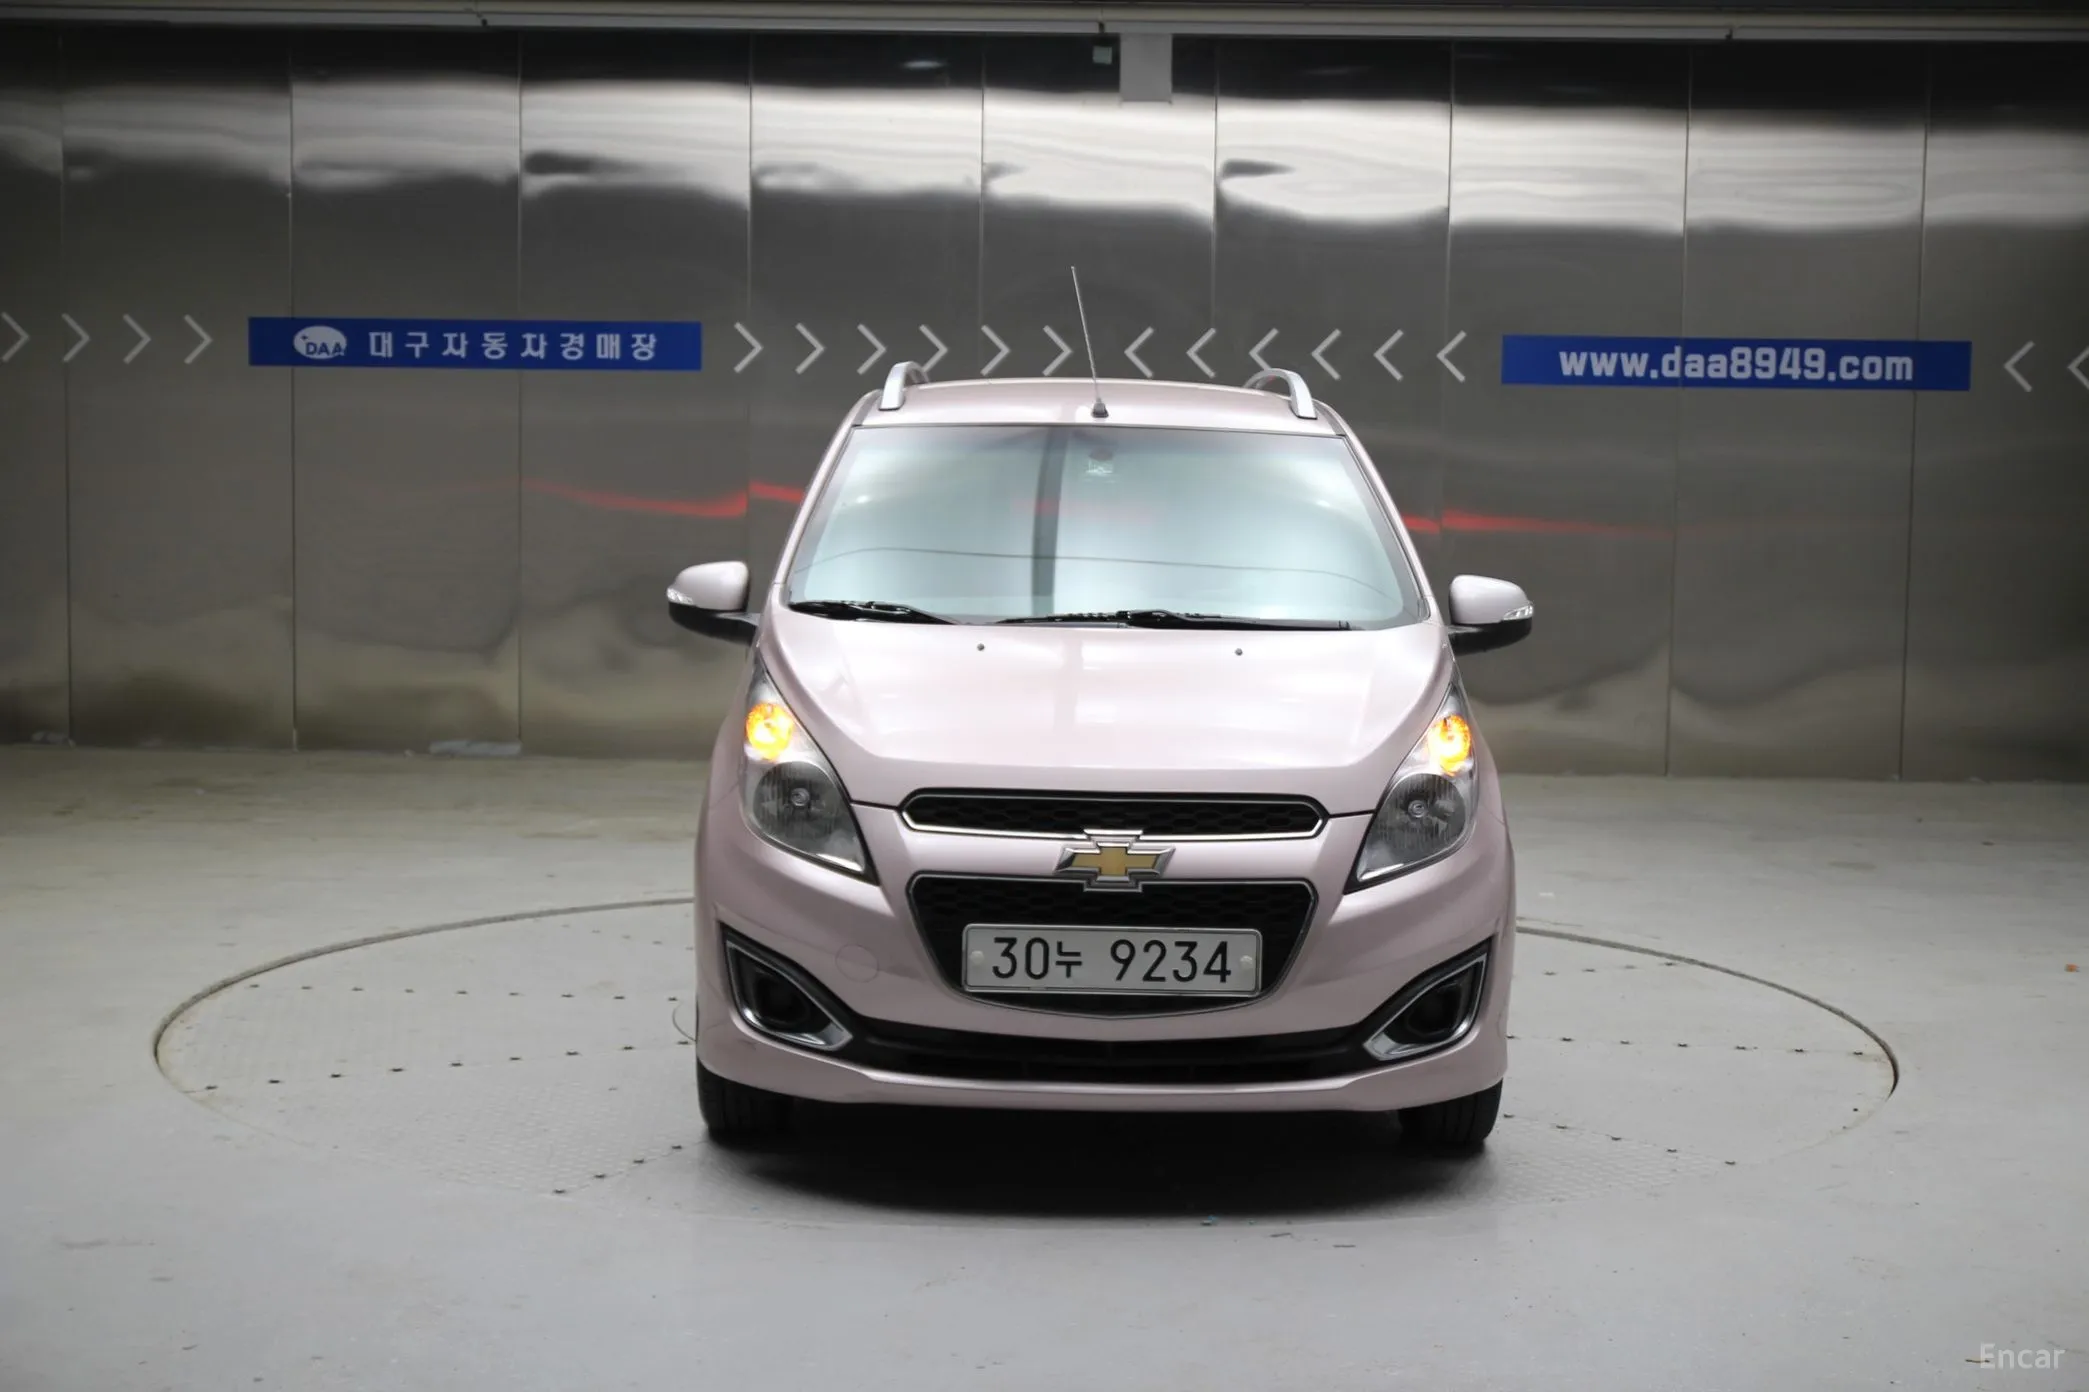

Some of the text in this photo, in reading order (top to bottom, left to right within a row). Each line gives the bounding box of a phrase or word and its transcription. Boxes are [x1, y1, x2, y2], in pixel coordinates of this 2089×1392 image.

[1559, 346, 1914, 382] www.daa8949.com
[992, 936, 1232, 984] 30누 9234
